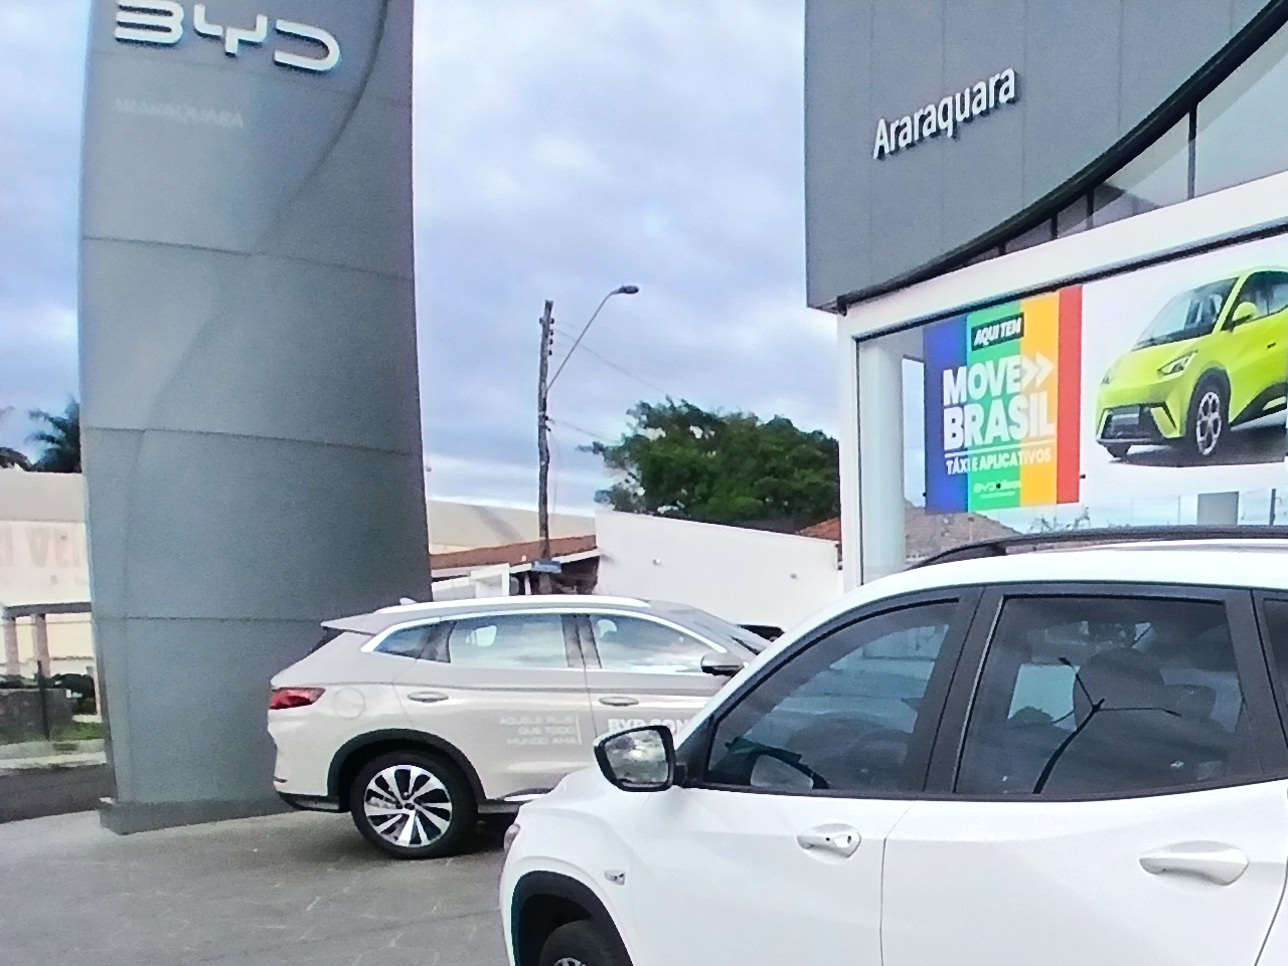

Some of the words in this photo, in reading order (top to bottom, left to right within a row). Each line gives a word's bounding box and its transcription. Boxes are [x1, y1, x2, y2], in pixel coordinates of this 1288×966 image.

[114, 0, 341, 72] BYD
[873, 67, 1015, 159] Araraquara
[973, 324, 1000, 346] AQUI
[1000, 317, 1022, 338] TEM
[943, 354, 1024, 406] MOVE
[943, 391, 1056, 451] BRASIL
[979, 447, 1052, 470] APLICATIVOS
